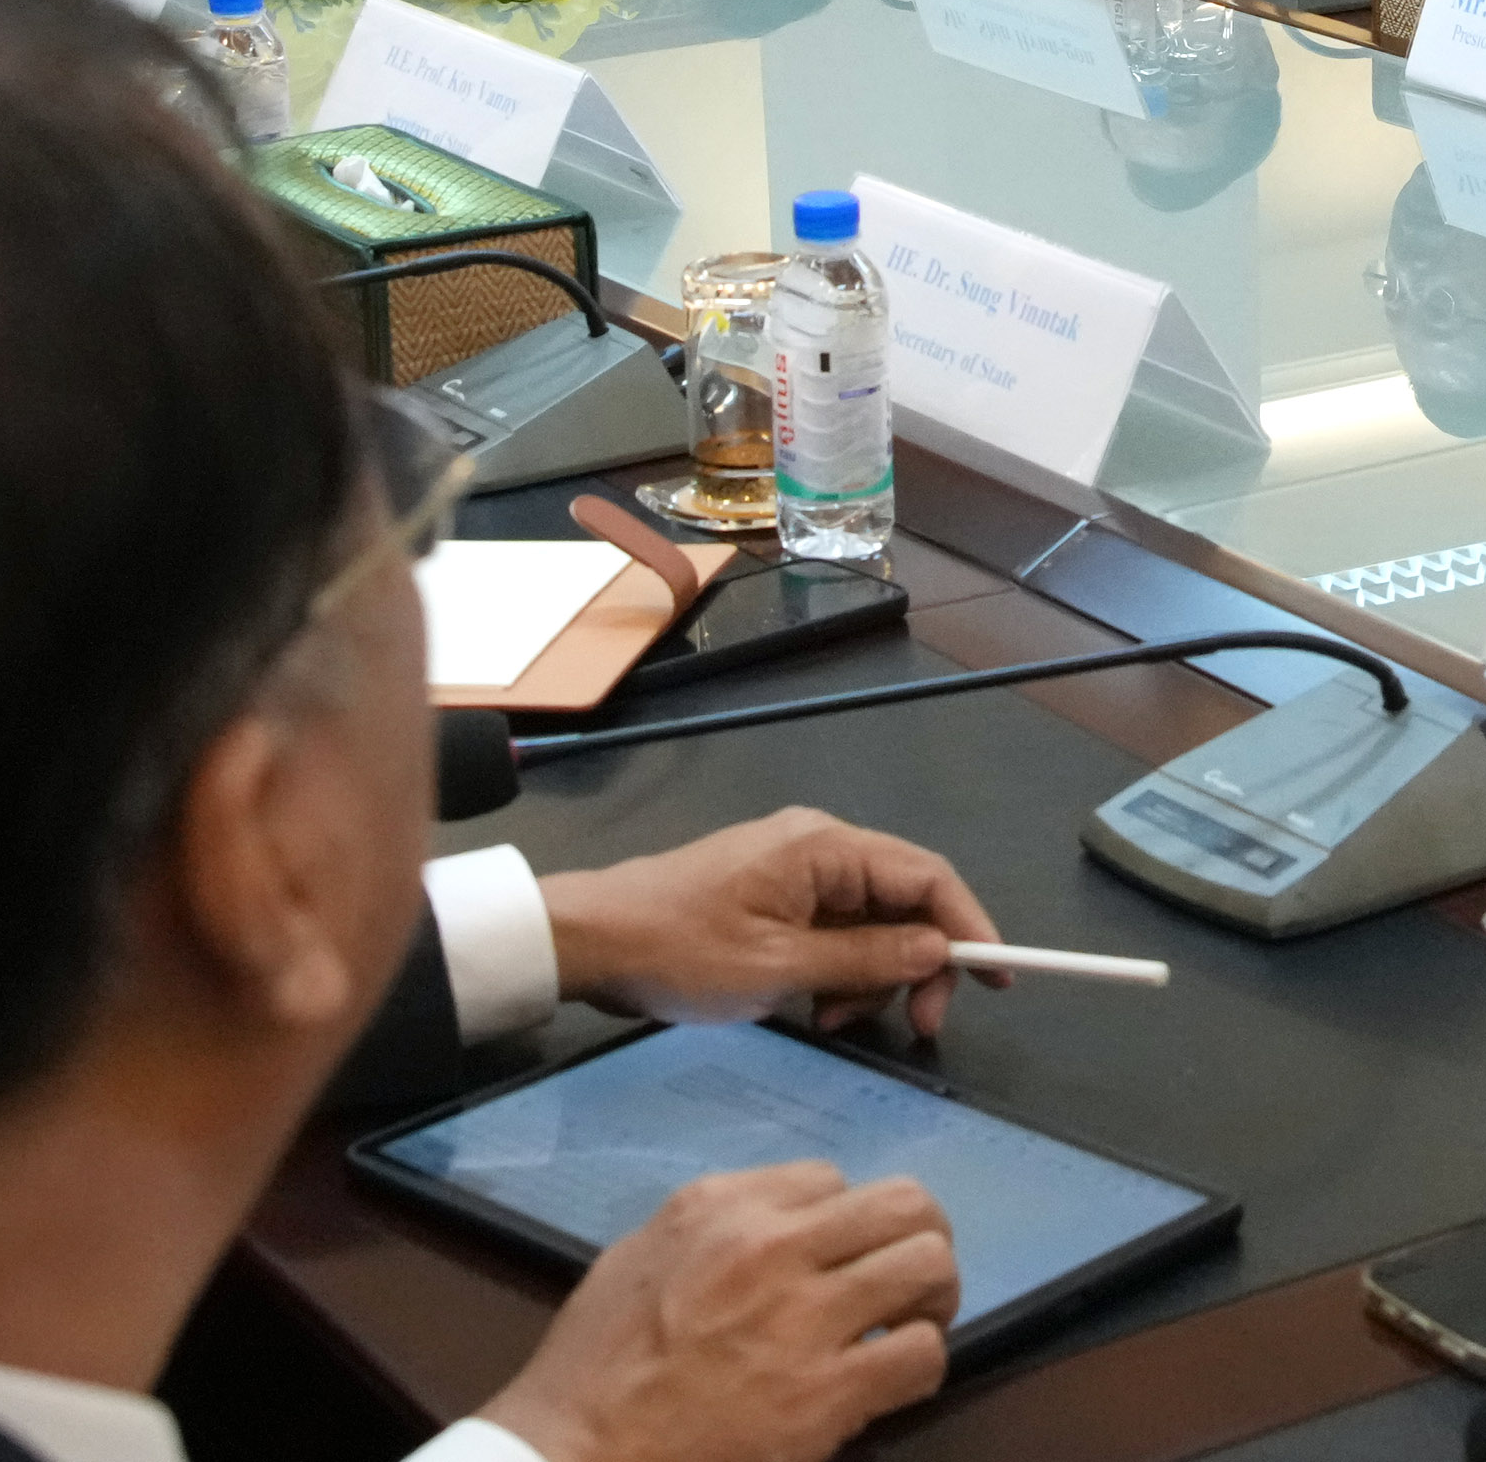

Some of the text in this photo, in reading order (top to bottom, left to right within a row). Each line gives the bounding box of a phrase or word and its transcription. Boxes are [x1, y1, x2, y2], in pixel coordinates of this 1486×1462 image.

[384, 45, 413, 74] H.E.
[415, 57, 446, 87] Prof.
[924, 258, 951, 291] Dr.
[956, 271, 1003, 315] Sung
[1008, 289, 1082, 341] Vinntak
[891, 323, 1018, 391] Secretary of State
